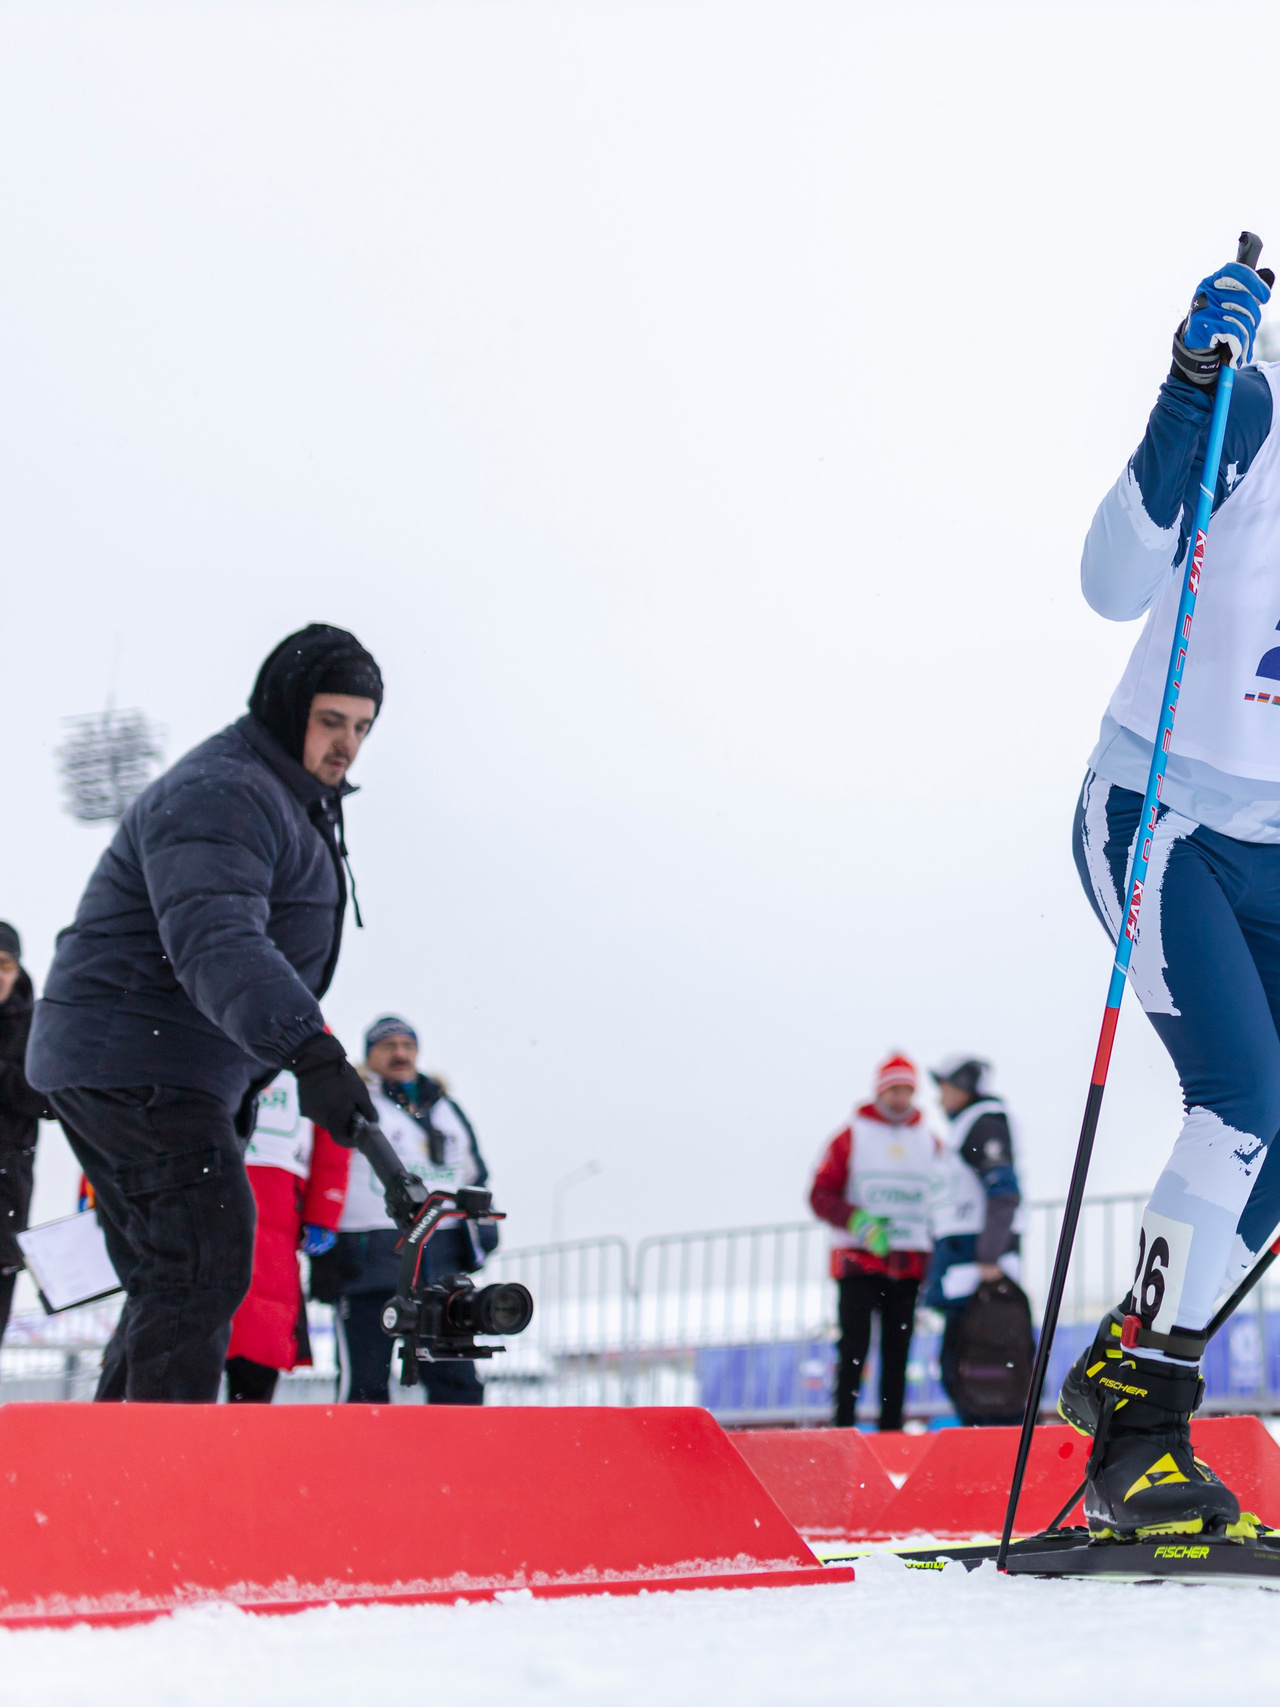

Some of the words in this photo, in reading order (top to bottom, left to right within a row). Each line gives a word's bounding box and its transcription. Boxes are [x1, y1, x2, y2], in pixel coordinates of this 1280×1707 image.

[1161, 613, 1191, 754] ELITE
[1140, 773, 1163, 863] PRO
[408, 1208, 438, 1243] RONIN
[1099, 1377, 1148, 1397] FISCHER
[1154, 1545, 1210, 1559] FISCHER
